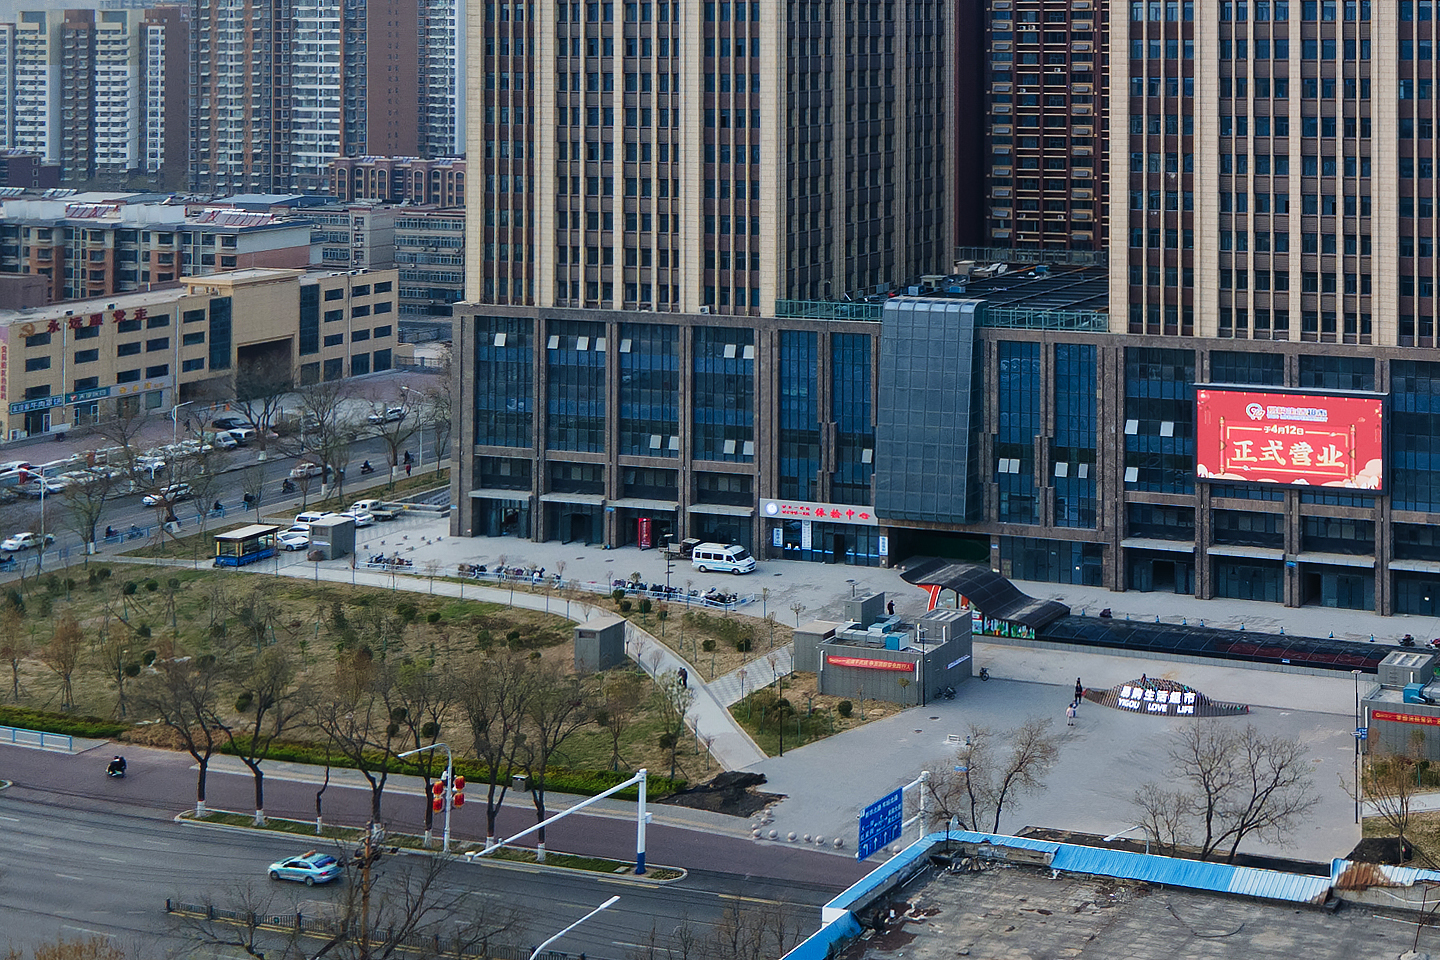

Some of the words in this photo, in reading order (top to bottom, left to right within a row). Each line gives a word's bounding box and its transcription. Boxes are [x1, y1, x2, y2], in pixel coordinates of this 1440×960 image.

[1263, 424, 1304, 436] 于4月12日
[1231, 439, 1345, 468] 正式营业
[1147, 702, 1168, 713] LOVE
[1176, 705, 1194, 714] LIFE
